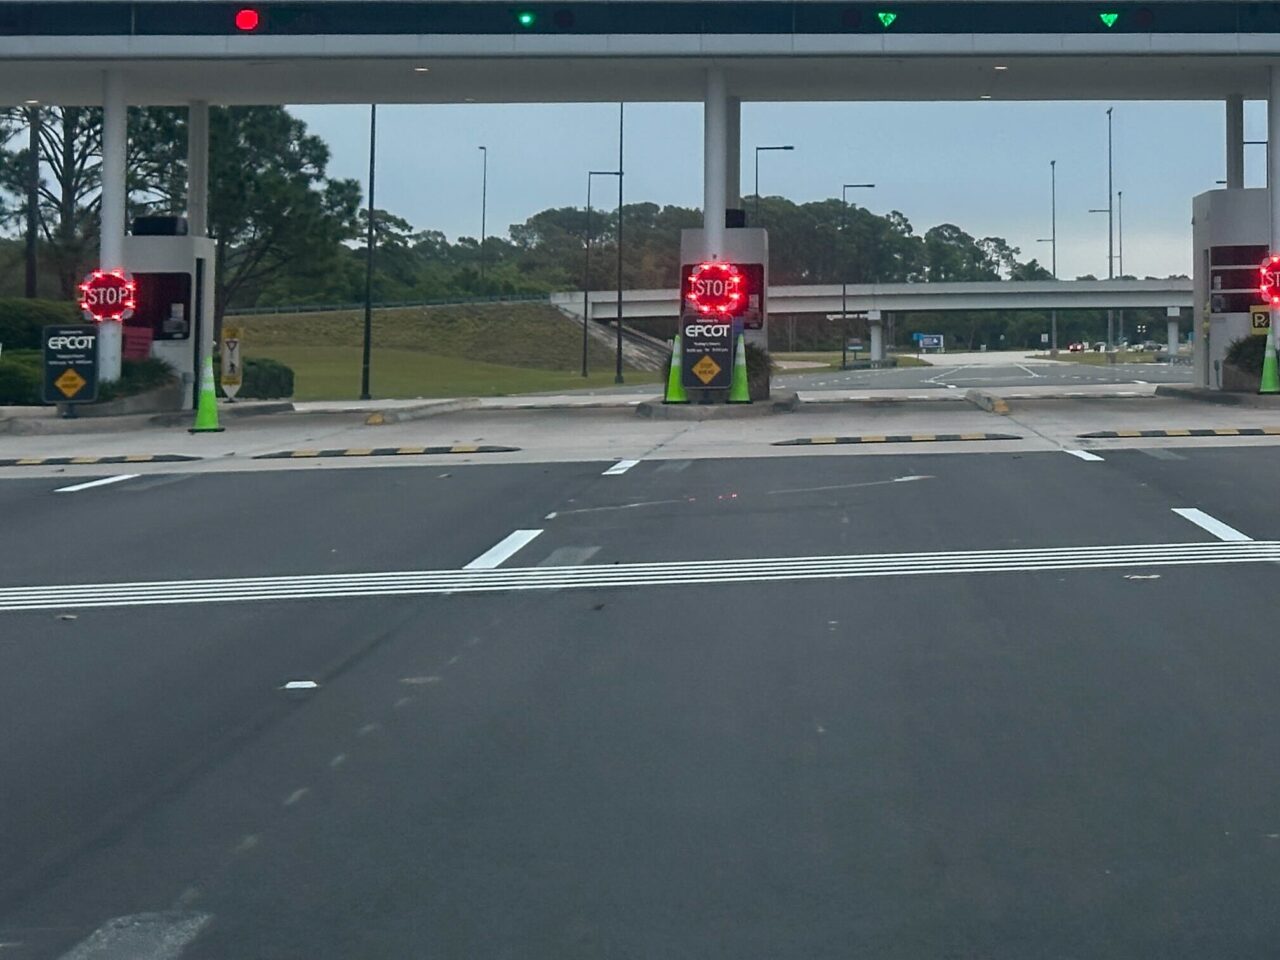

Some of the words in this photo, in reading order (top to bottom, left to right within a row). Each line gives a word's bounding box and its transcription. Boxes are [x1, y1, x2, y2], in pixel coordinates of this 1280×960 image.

[695, 279, 734, 296] STOP
[88, 287, 128, 305] STOP
[685, 324, 730, 337] EPCOT
[48, 336, 95, 349] EPCOT
